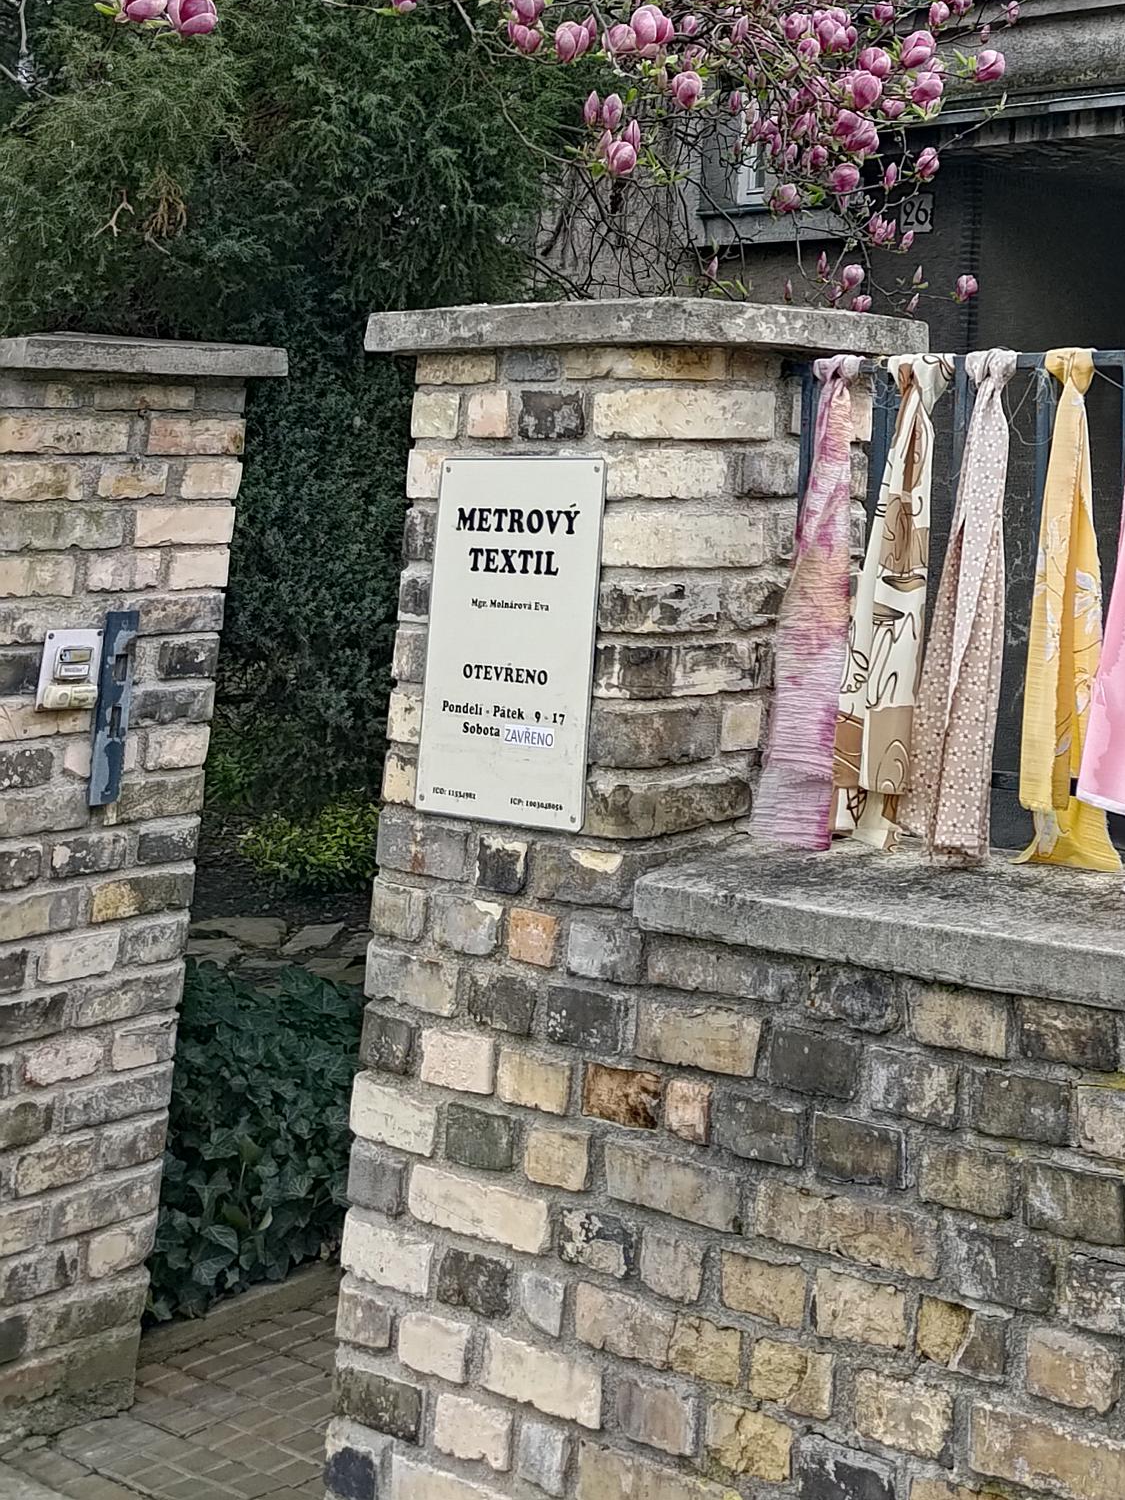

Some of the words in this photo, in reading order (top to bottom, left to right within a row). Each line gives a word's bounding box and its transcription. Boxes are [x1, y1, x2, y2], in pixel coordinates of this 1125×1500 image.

[904, 200, 928, 225] 26
[456, 503, 580, 535] METROVÝ
[469, 548, 559, 576] TEXTIL
[471, 598, 488, 608] Mgr.
[489, 600, 532, 611] Molnárová
[534, 602, 549, 611] Eva
[534, 711, 541, 723] 9
[552, 712, 565, 725] 17
[462, 722, 500, 737] Sobota
[504, 727, 554, 747] ZAVŘENO
